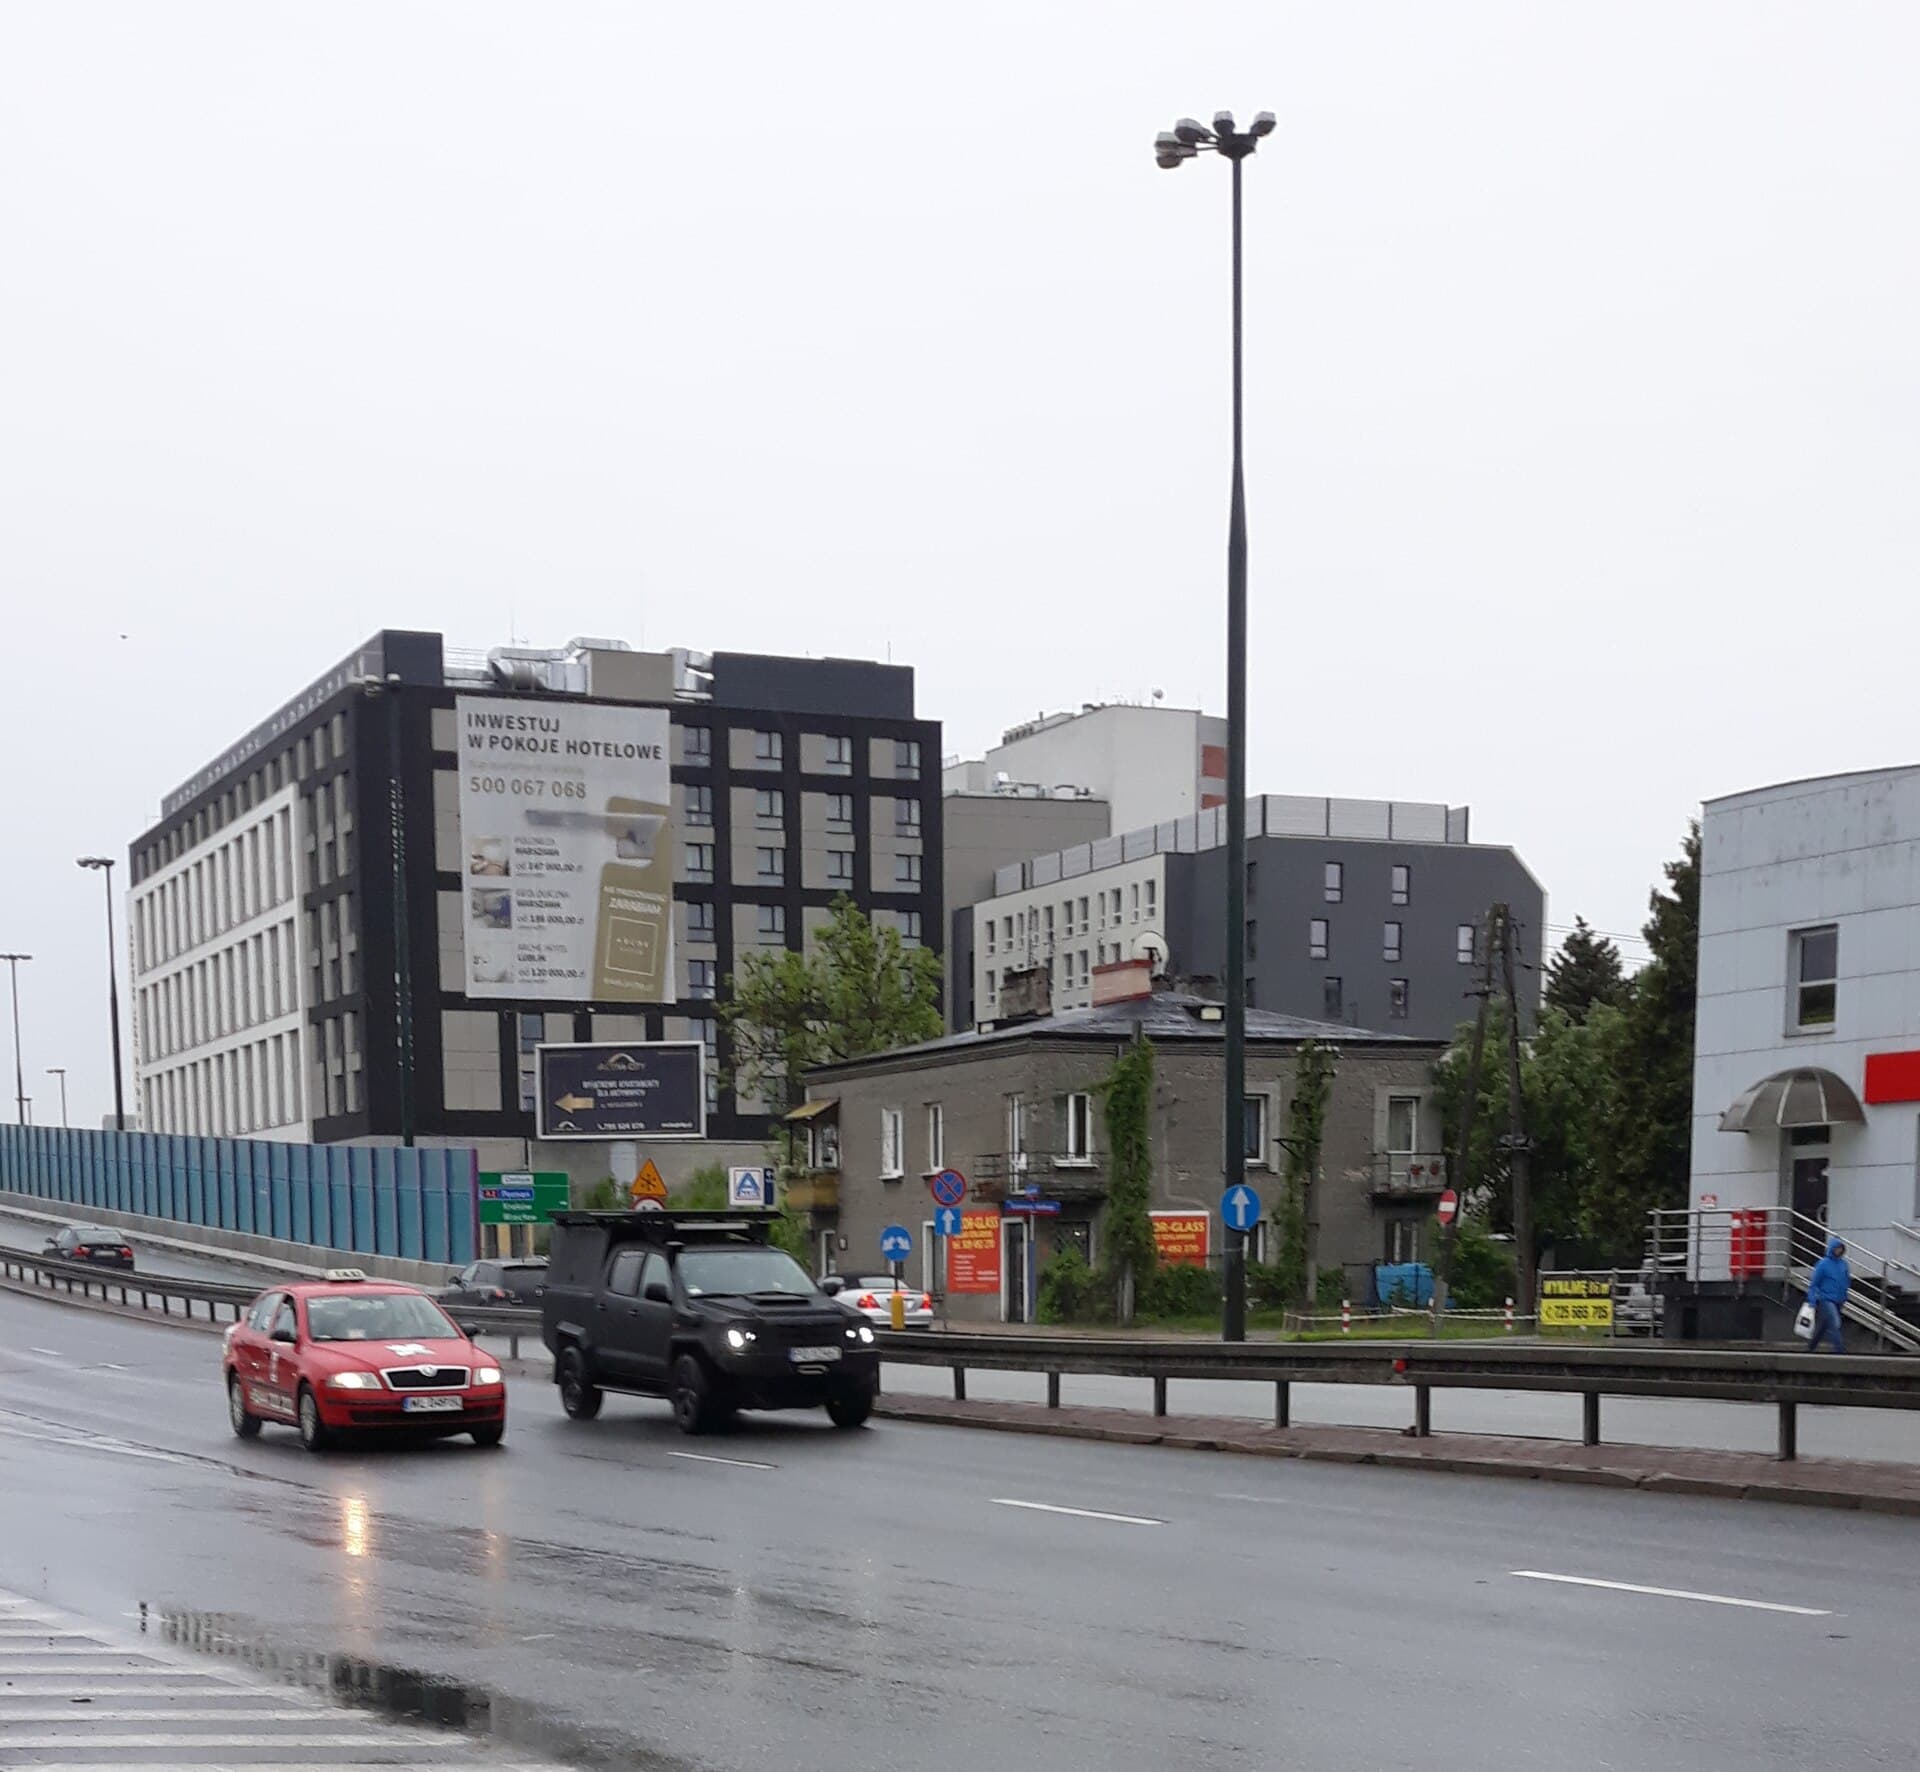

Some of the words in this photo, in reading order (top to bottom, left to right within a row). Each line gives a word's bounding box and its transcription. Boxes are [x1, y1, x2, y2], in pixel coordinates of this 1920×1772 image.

[467, 713, 560, 732] INWESTUJ
[467, 734, 483, 749] W
[489, 735, 560, 753] POKOJE
[566, 740, 663, 760] HOTELOWE
[470, 777, 506, 795] 500
[511, 779, 545, 796] 067
[552, 781, 586, 799] 068
